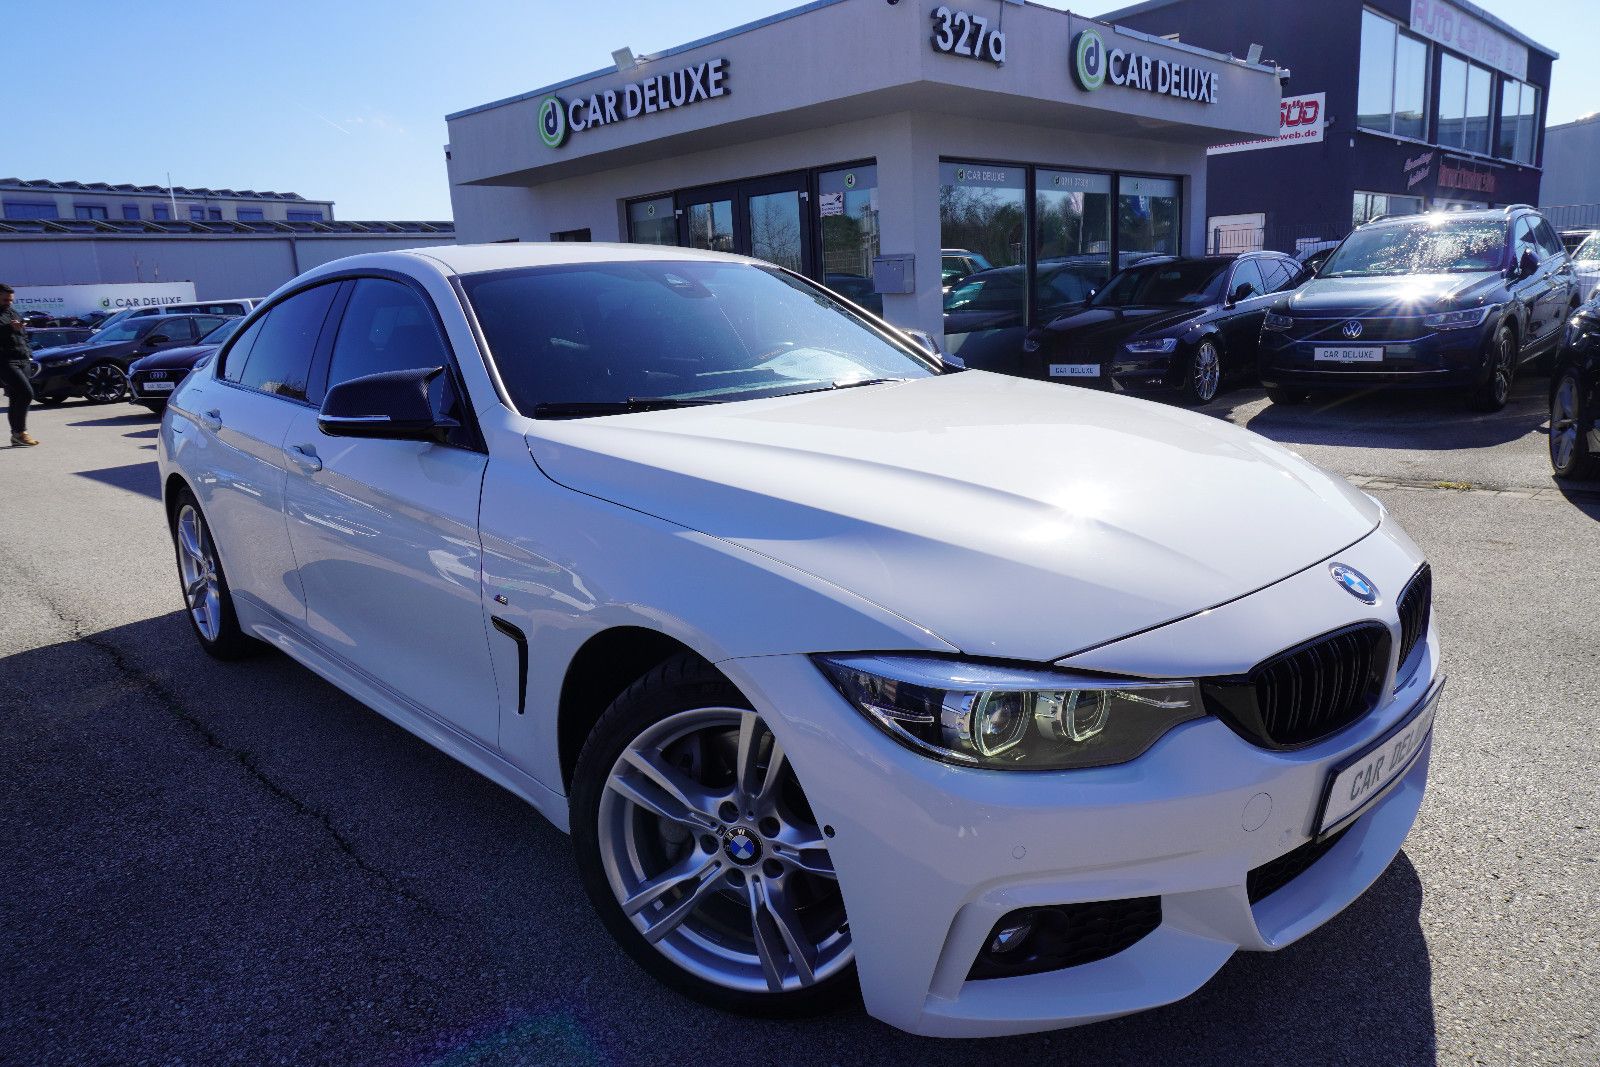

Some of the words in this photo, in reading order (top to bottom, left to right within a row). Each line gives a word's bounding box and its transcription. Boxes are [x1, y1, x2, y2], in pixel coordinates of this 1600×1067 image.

[936, 6, 1005, 63] 327a
[568, 90, 619, 132] CAR
[624, 58, 724, 118] DELUXE
[1109, 48, 1152, 91] CAR
[1157, 59, 1219, 104] DELUXE
[14, 297, 64, 305] UTOHAUS
[115, 298, 140, 307] CAR
[142, 296, 182, 306] DELUXE
[1323, 350, 1339, 358] CAR
[1342, 350, 1374, 359] DELUXE
[1350, 755, 1385, 801] CAR
